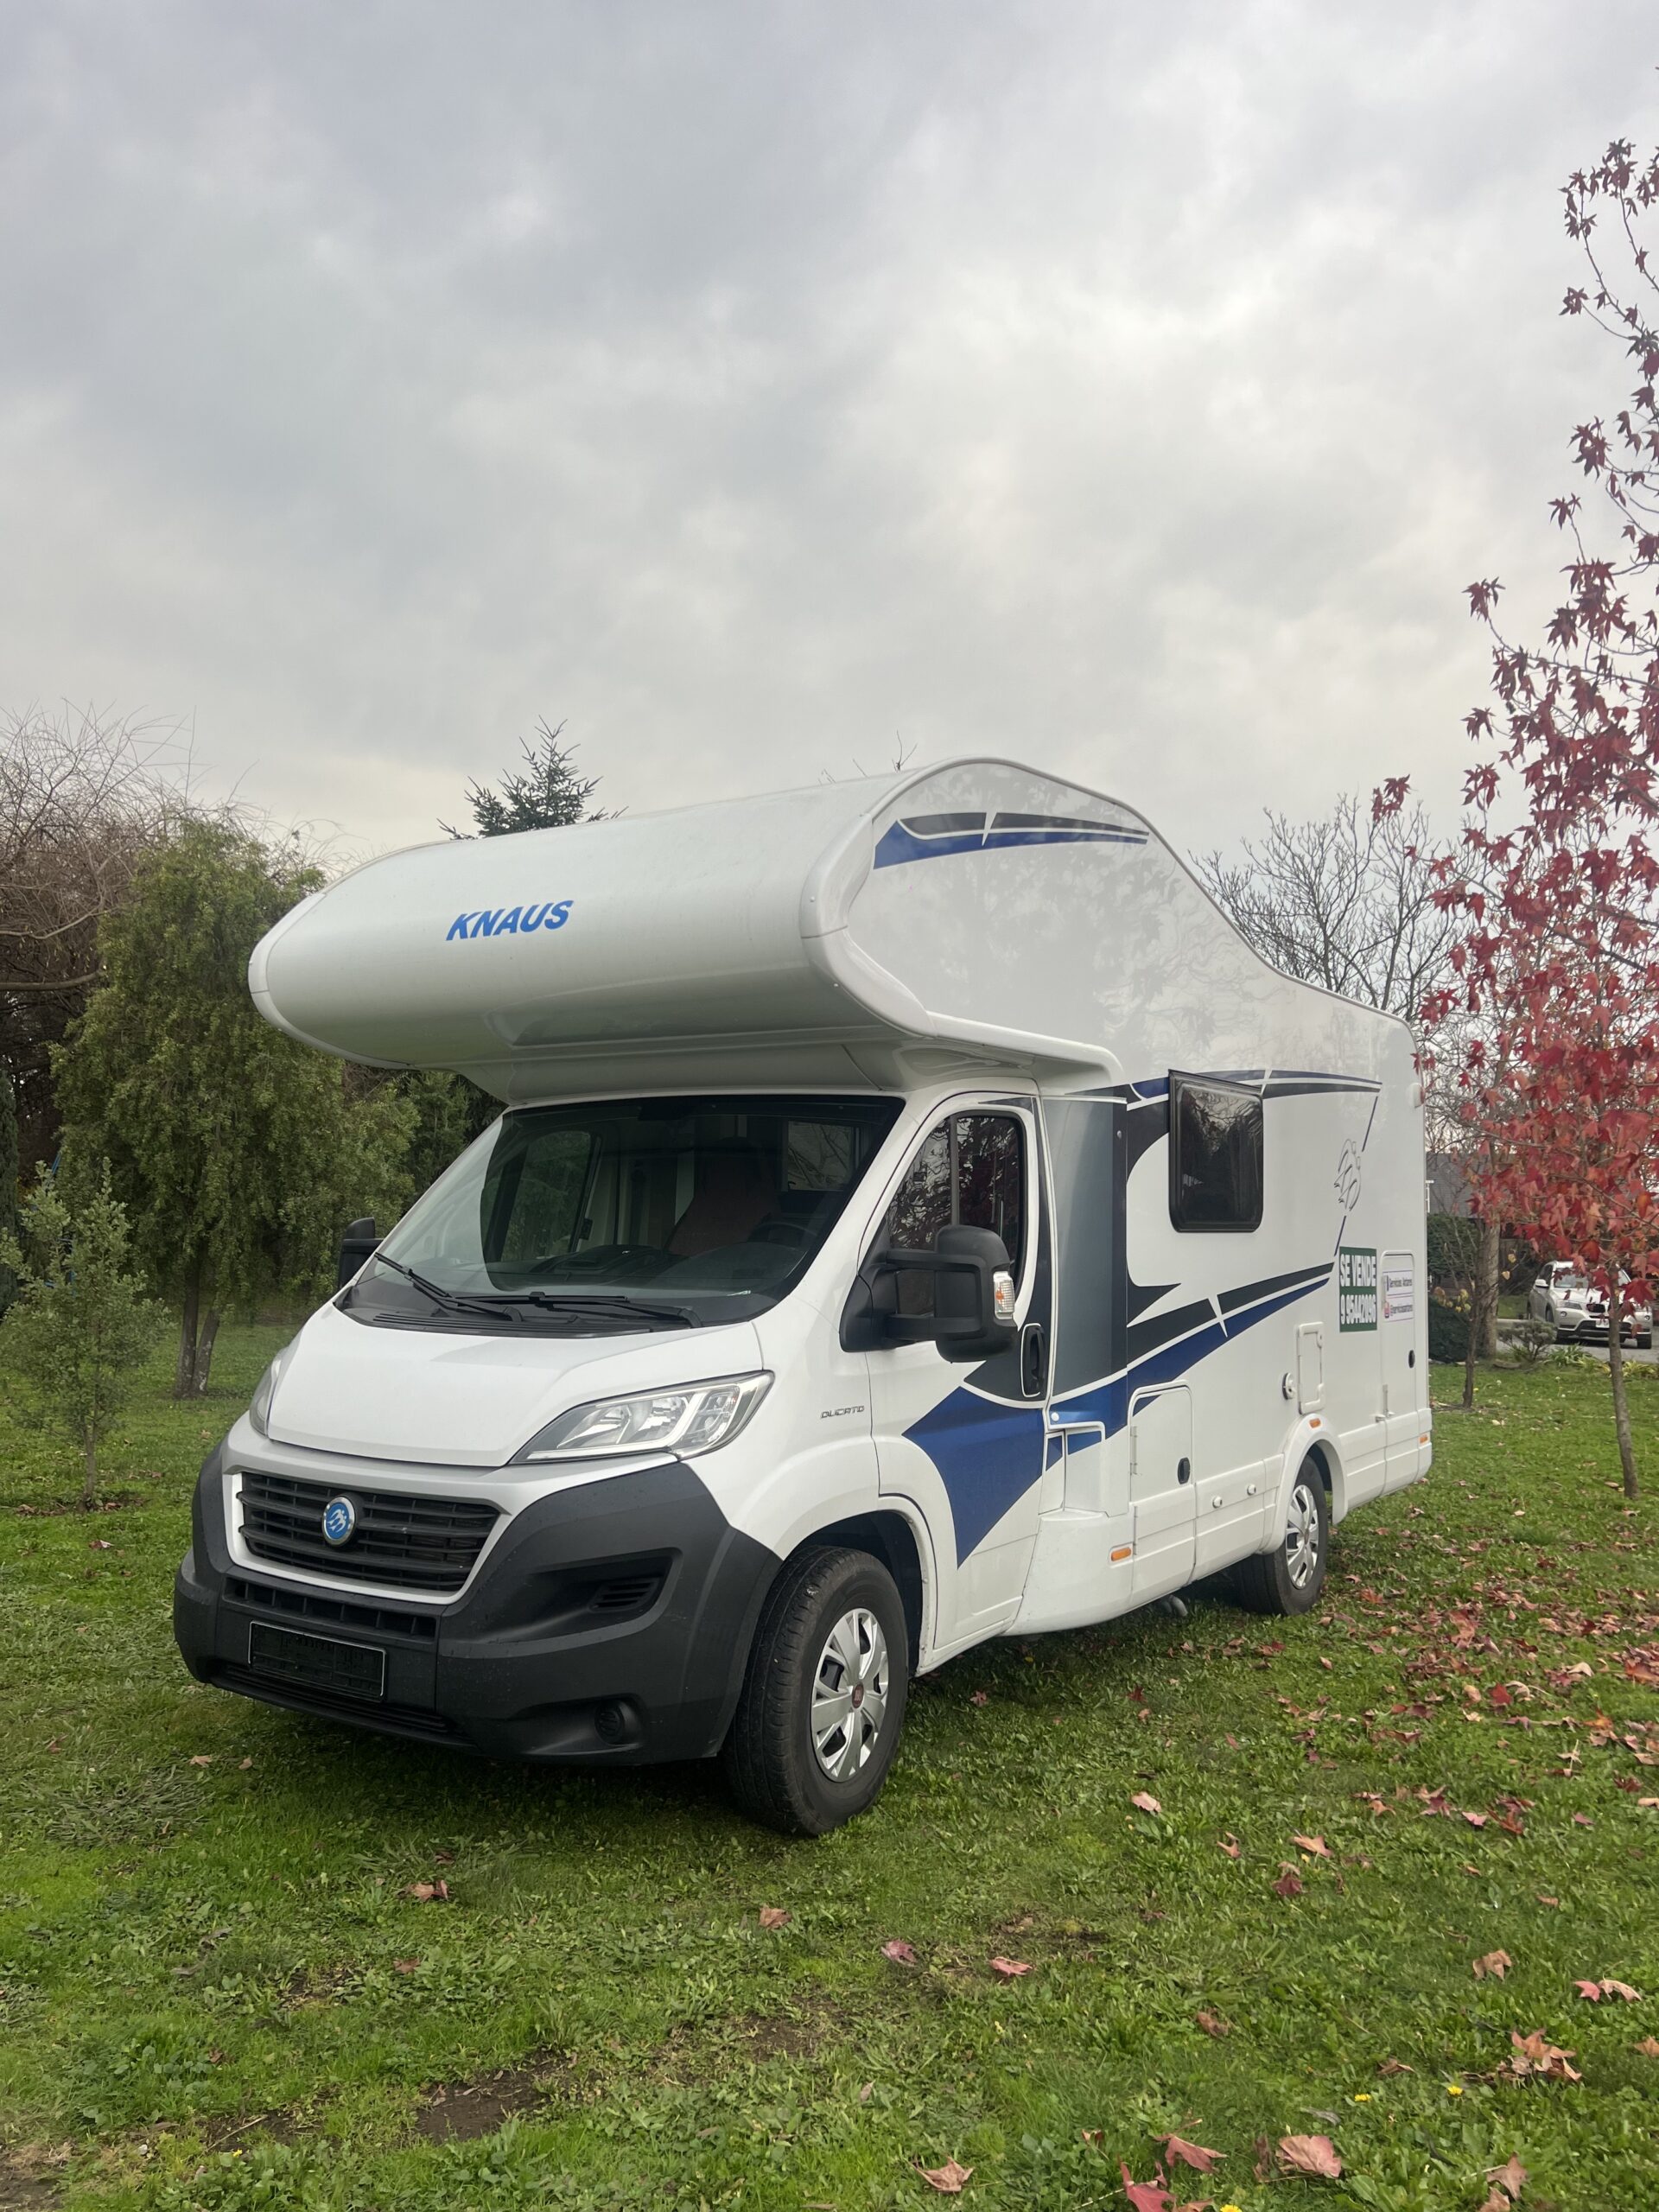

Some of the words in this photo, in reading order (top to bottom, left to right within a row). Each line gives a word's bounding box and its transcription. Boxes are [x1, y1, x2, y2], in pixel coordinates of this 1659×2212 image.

[445, 899, 575, 941] KNAUS
[1340, 1254, 1351, 1287] SE
[1351, 1255, 1376, 1287] VENDE
[1340, 1294, 1345, 1325] 9
[820, 1405, 865, 1419] DUCATO
